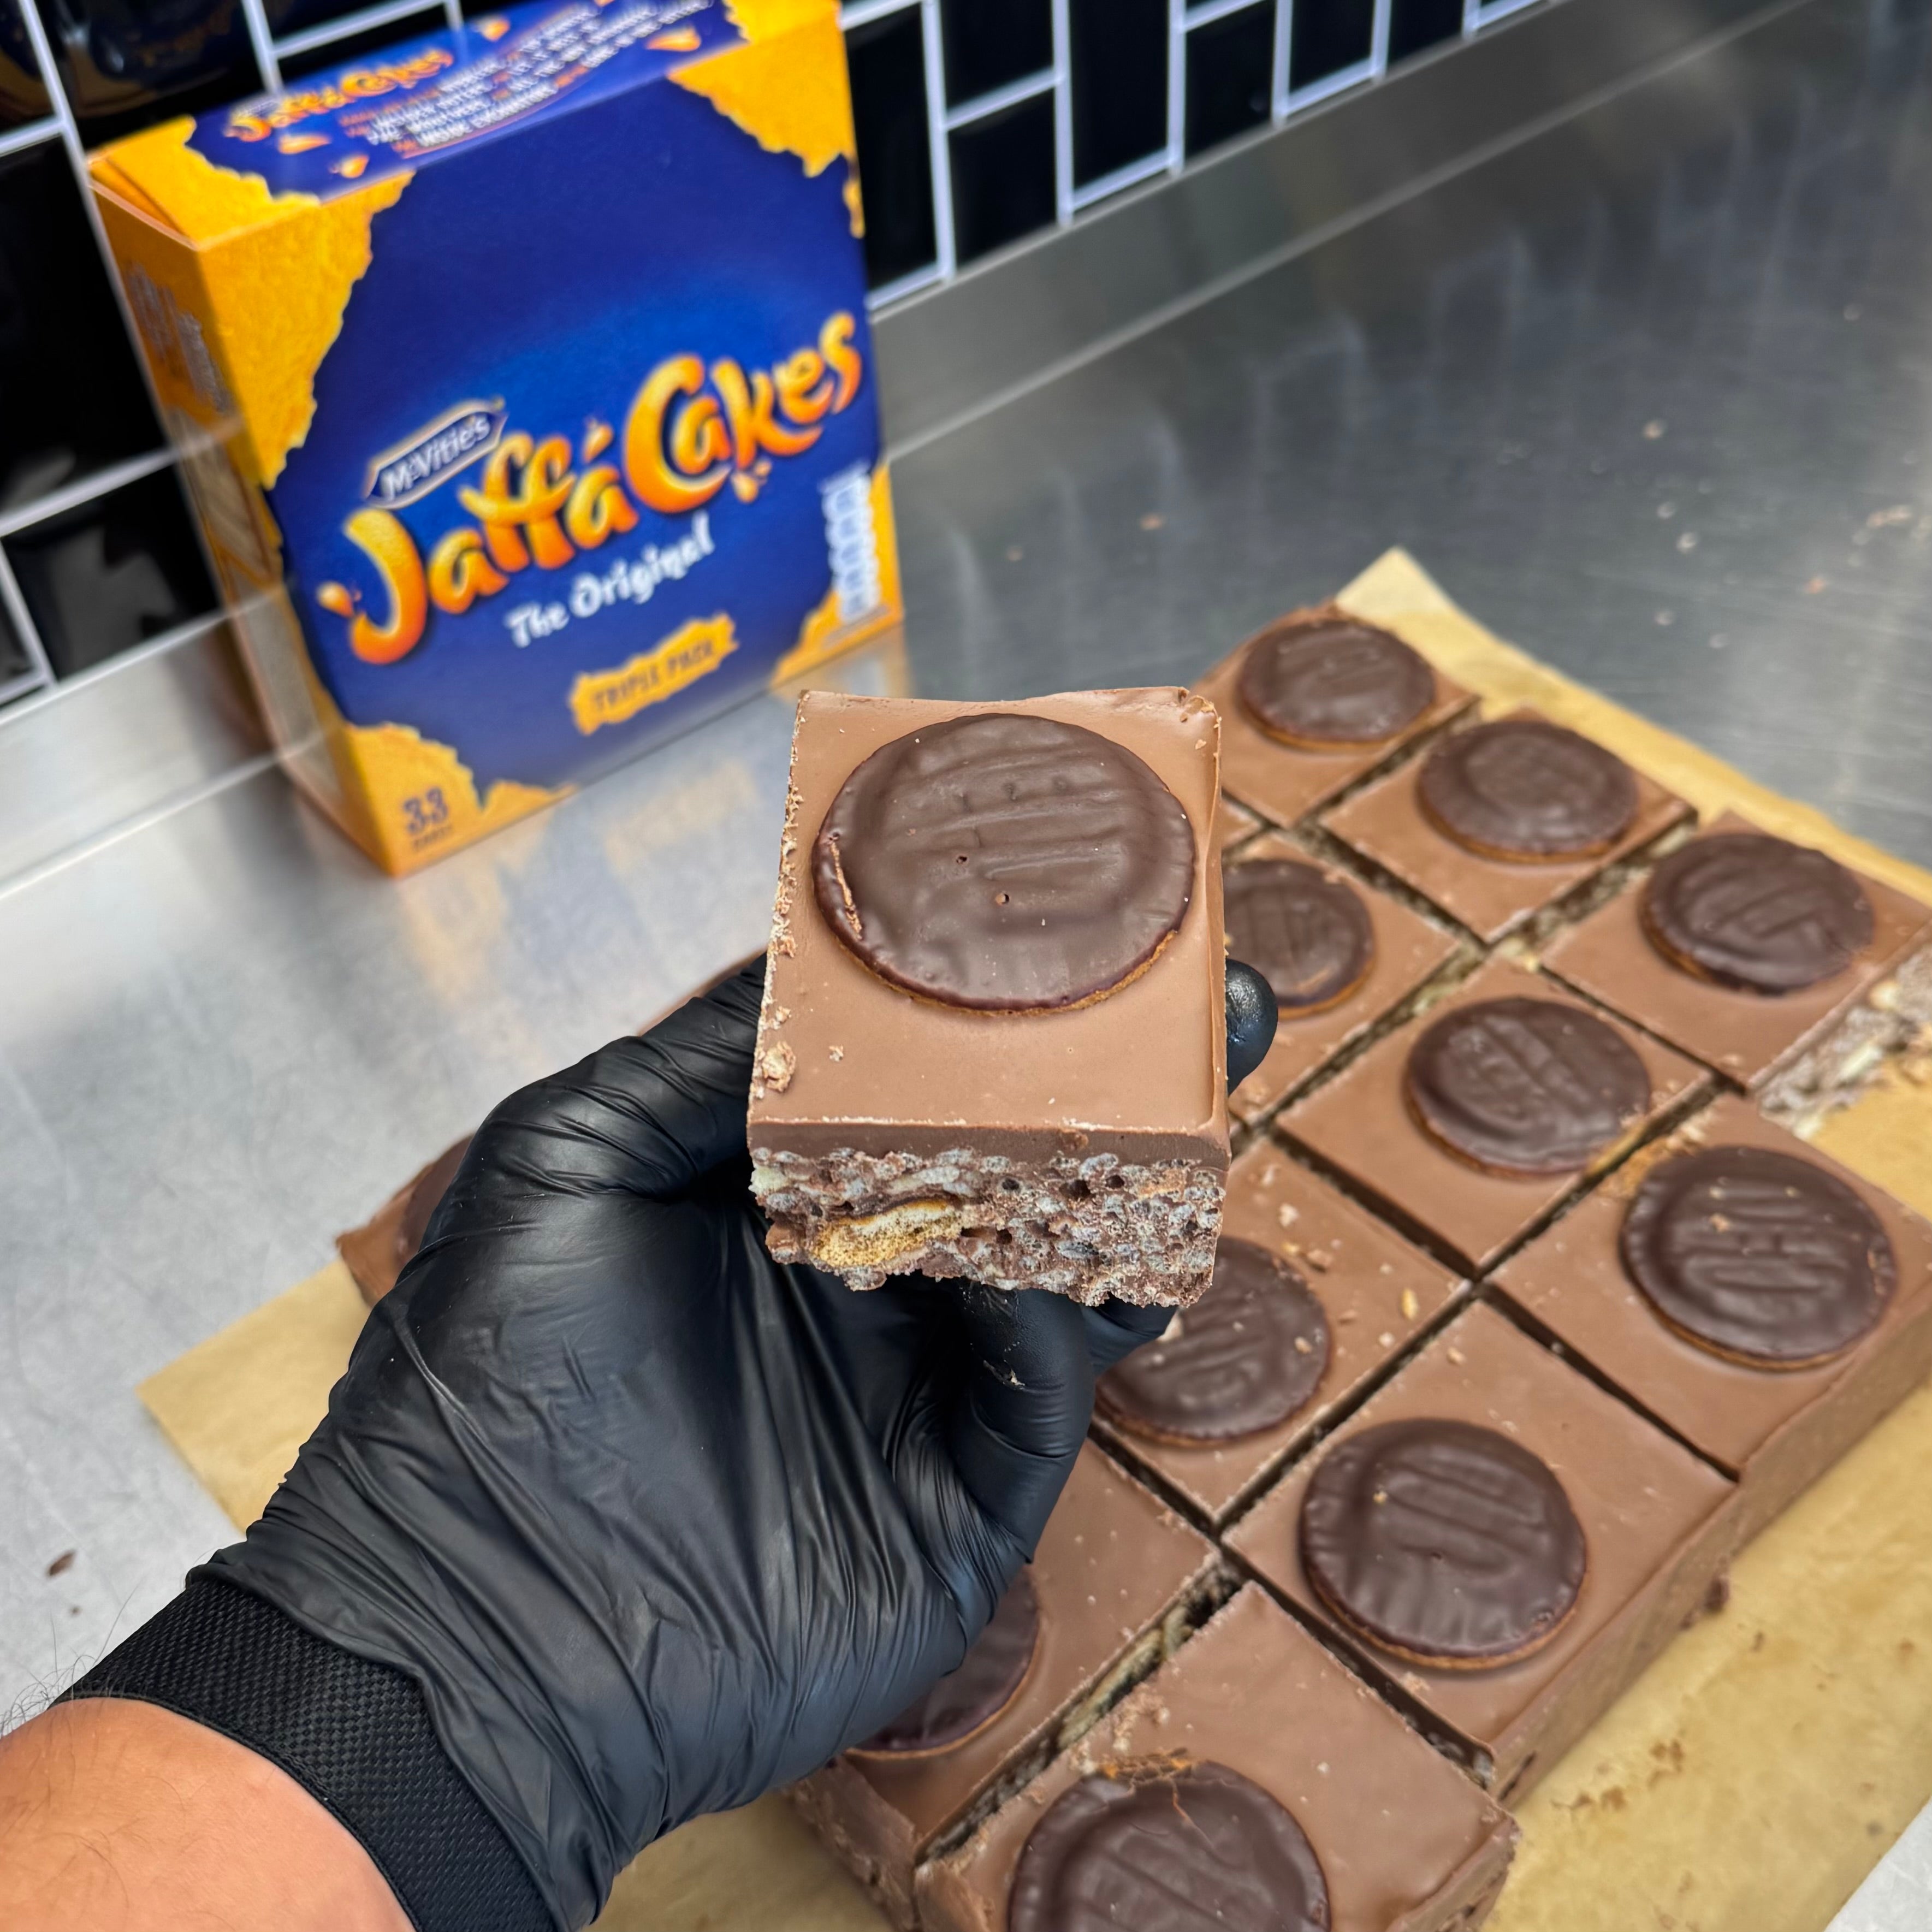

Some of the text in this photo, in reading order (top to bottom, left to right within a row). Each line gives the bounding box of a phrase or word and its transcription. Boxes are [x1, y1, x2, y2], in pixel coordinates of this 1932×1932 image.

[343, 432, 639, 665] Jaffa
[623, 311, 862, 513] Cakes
[503, 509, 715, 649] The Original
[403, 786, 449, 834] 33
